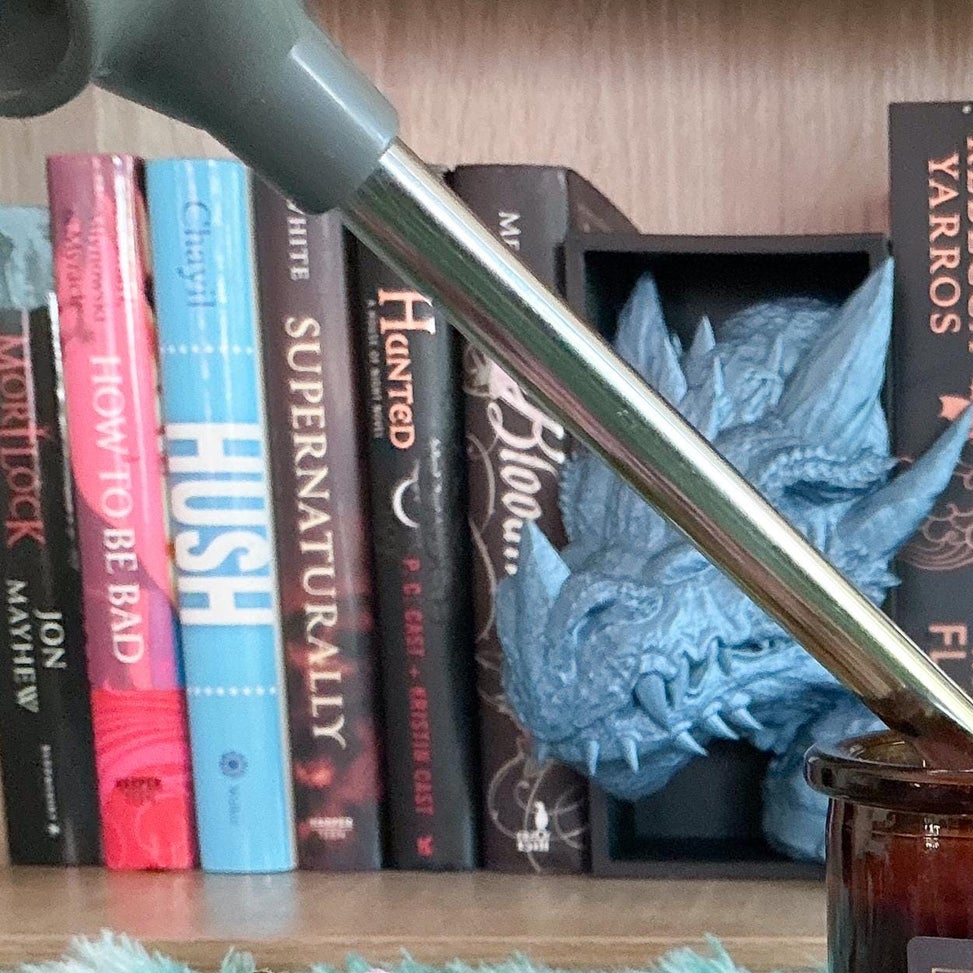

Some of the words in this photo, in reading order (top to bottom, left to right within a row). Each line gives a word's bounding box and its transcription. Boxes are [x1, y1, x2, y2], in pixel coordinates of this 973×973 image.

[928, 153, 961, 334] YARROS
[88, 355, 128, 456] HOW
[98, 458, 134, 519] TO
[165, 421, 277, 626] HUSH
[284, 315, 347, 749] SUPERNATURALLY
[103, 528, 140, 575] BE
[6, 578, 40, 713] MAYHEW
[33, 608, 67, 669] JON
[108, 583, 145, 665] BAD
